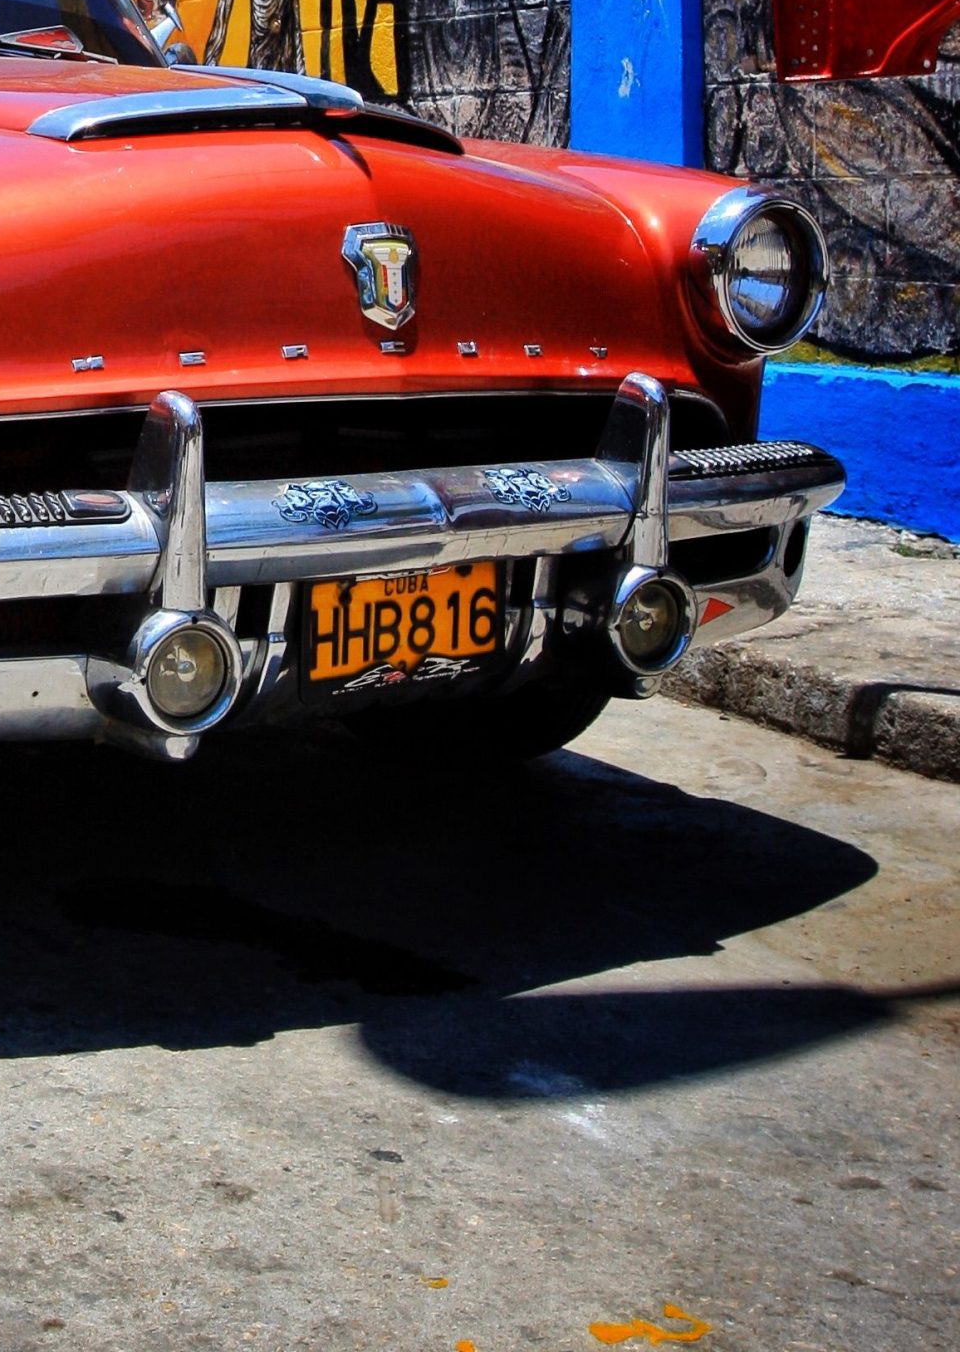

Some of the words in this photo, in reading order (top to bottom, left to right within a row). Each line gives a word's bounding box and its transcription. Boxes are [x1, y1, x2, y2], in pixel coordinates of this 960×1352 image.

[71, 339, 608, 371] MERCURY
[383, 575, 429, 596] CUBA
[310, 587, 497, 671] HHB816
